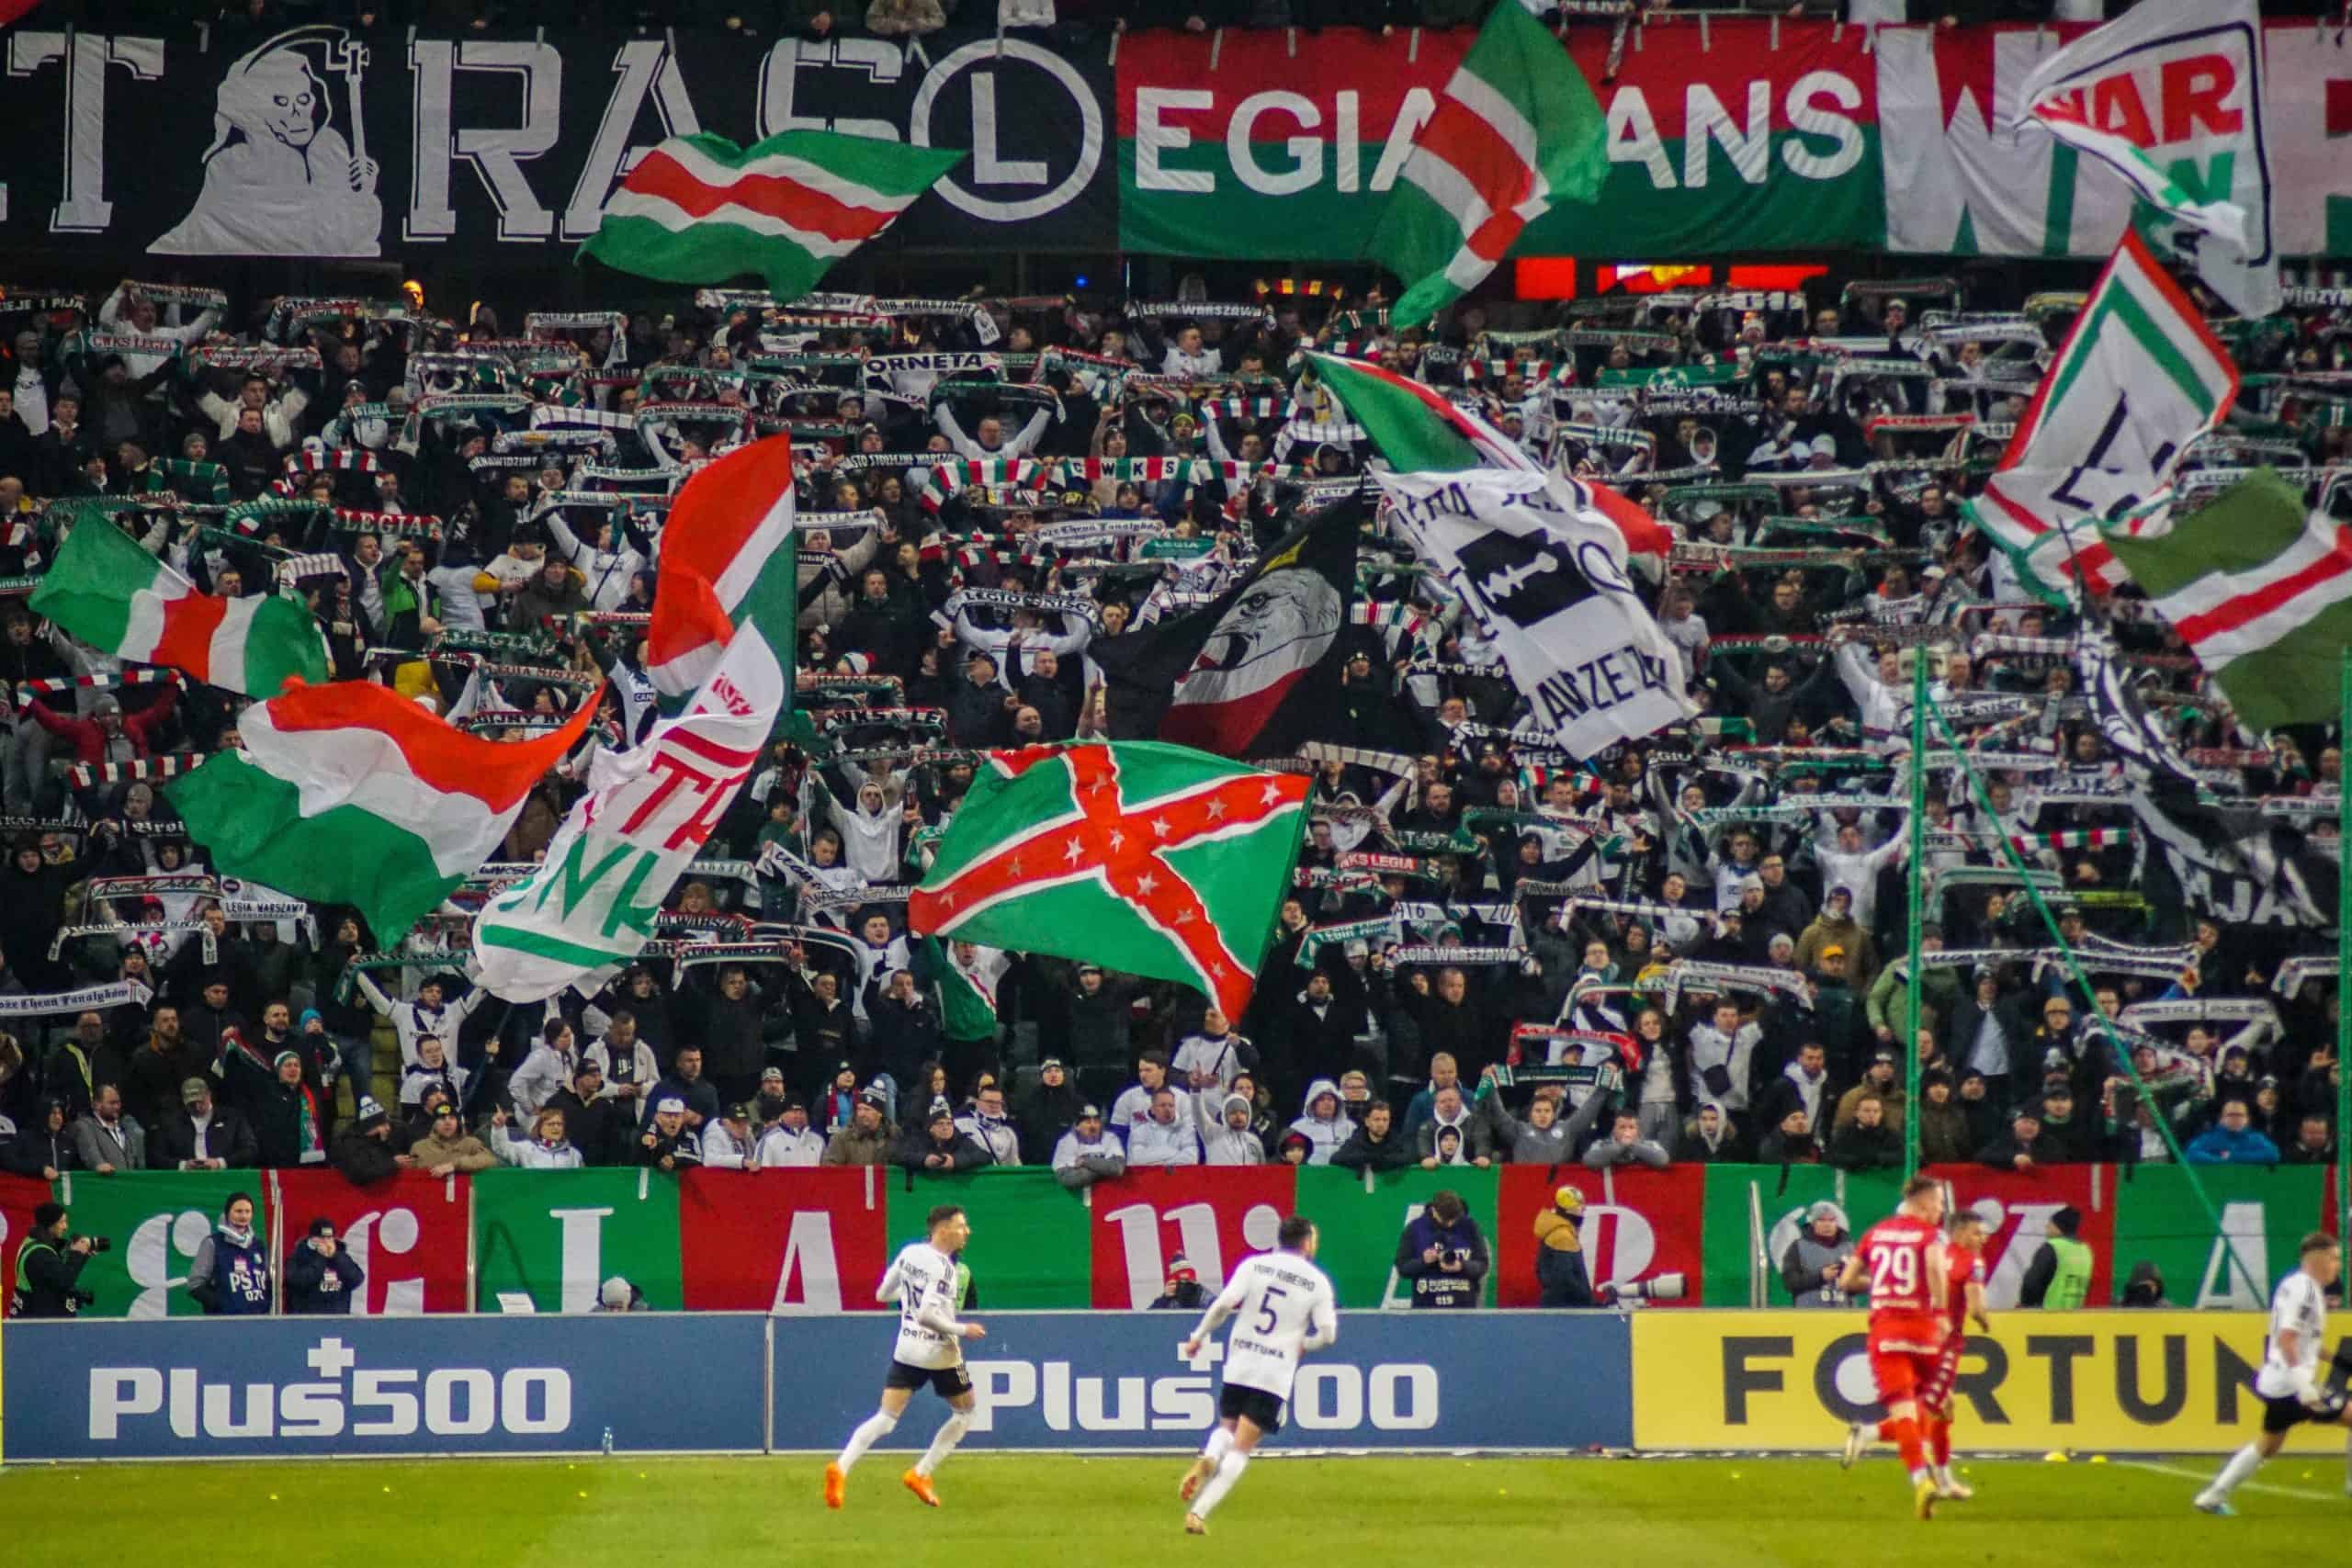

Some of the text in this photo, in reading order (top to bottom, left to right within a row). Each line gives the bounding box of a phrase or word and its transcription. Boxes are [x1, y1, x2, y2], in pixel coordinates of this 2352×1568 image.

[1608, 70, 1864, 189] ANS
[866, 353, 983, 371] ORNETA
[343, 510, 424, 535] LEGIA
[1372, 853, 1415, 871] LEGIA
[225, 902, 305, 915] LEGIA WARSZAWA
[1871, 1245, 1917, 1295] 29
[1253, 1285, 1287, 1336] 5
[89, 1359, 571, 1439] Plus500
[969, 1359, 1440, 1432] Plus00
